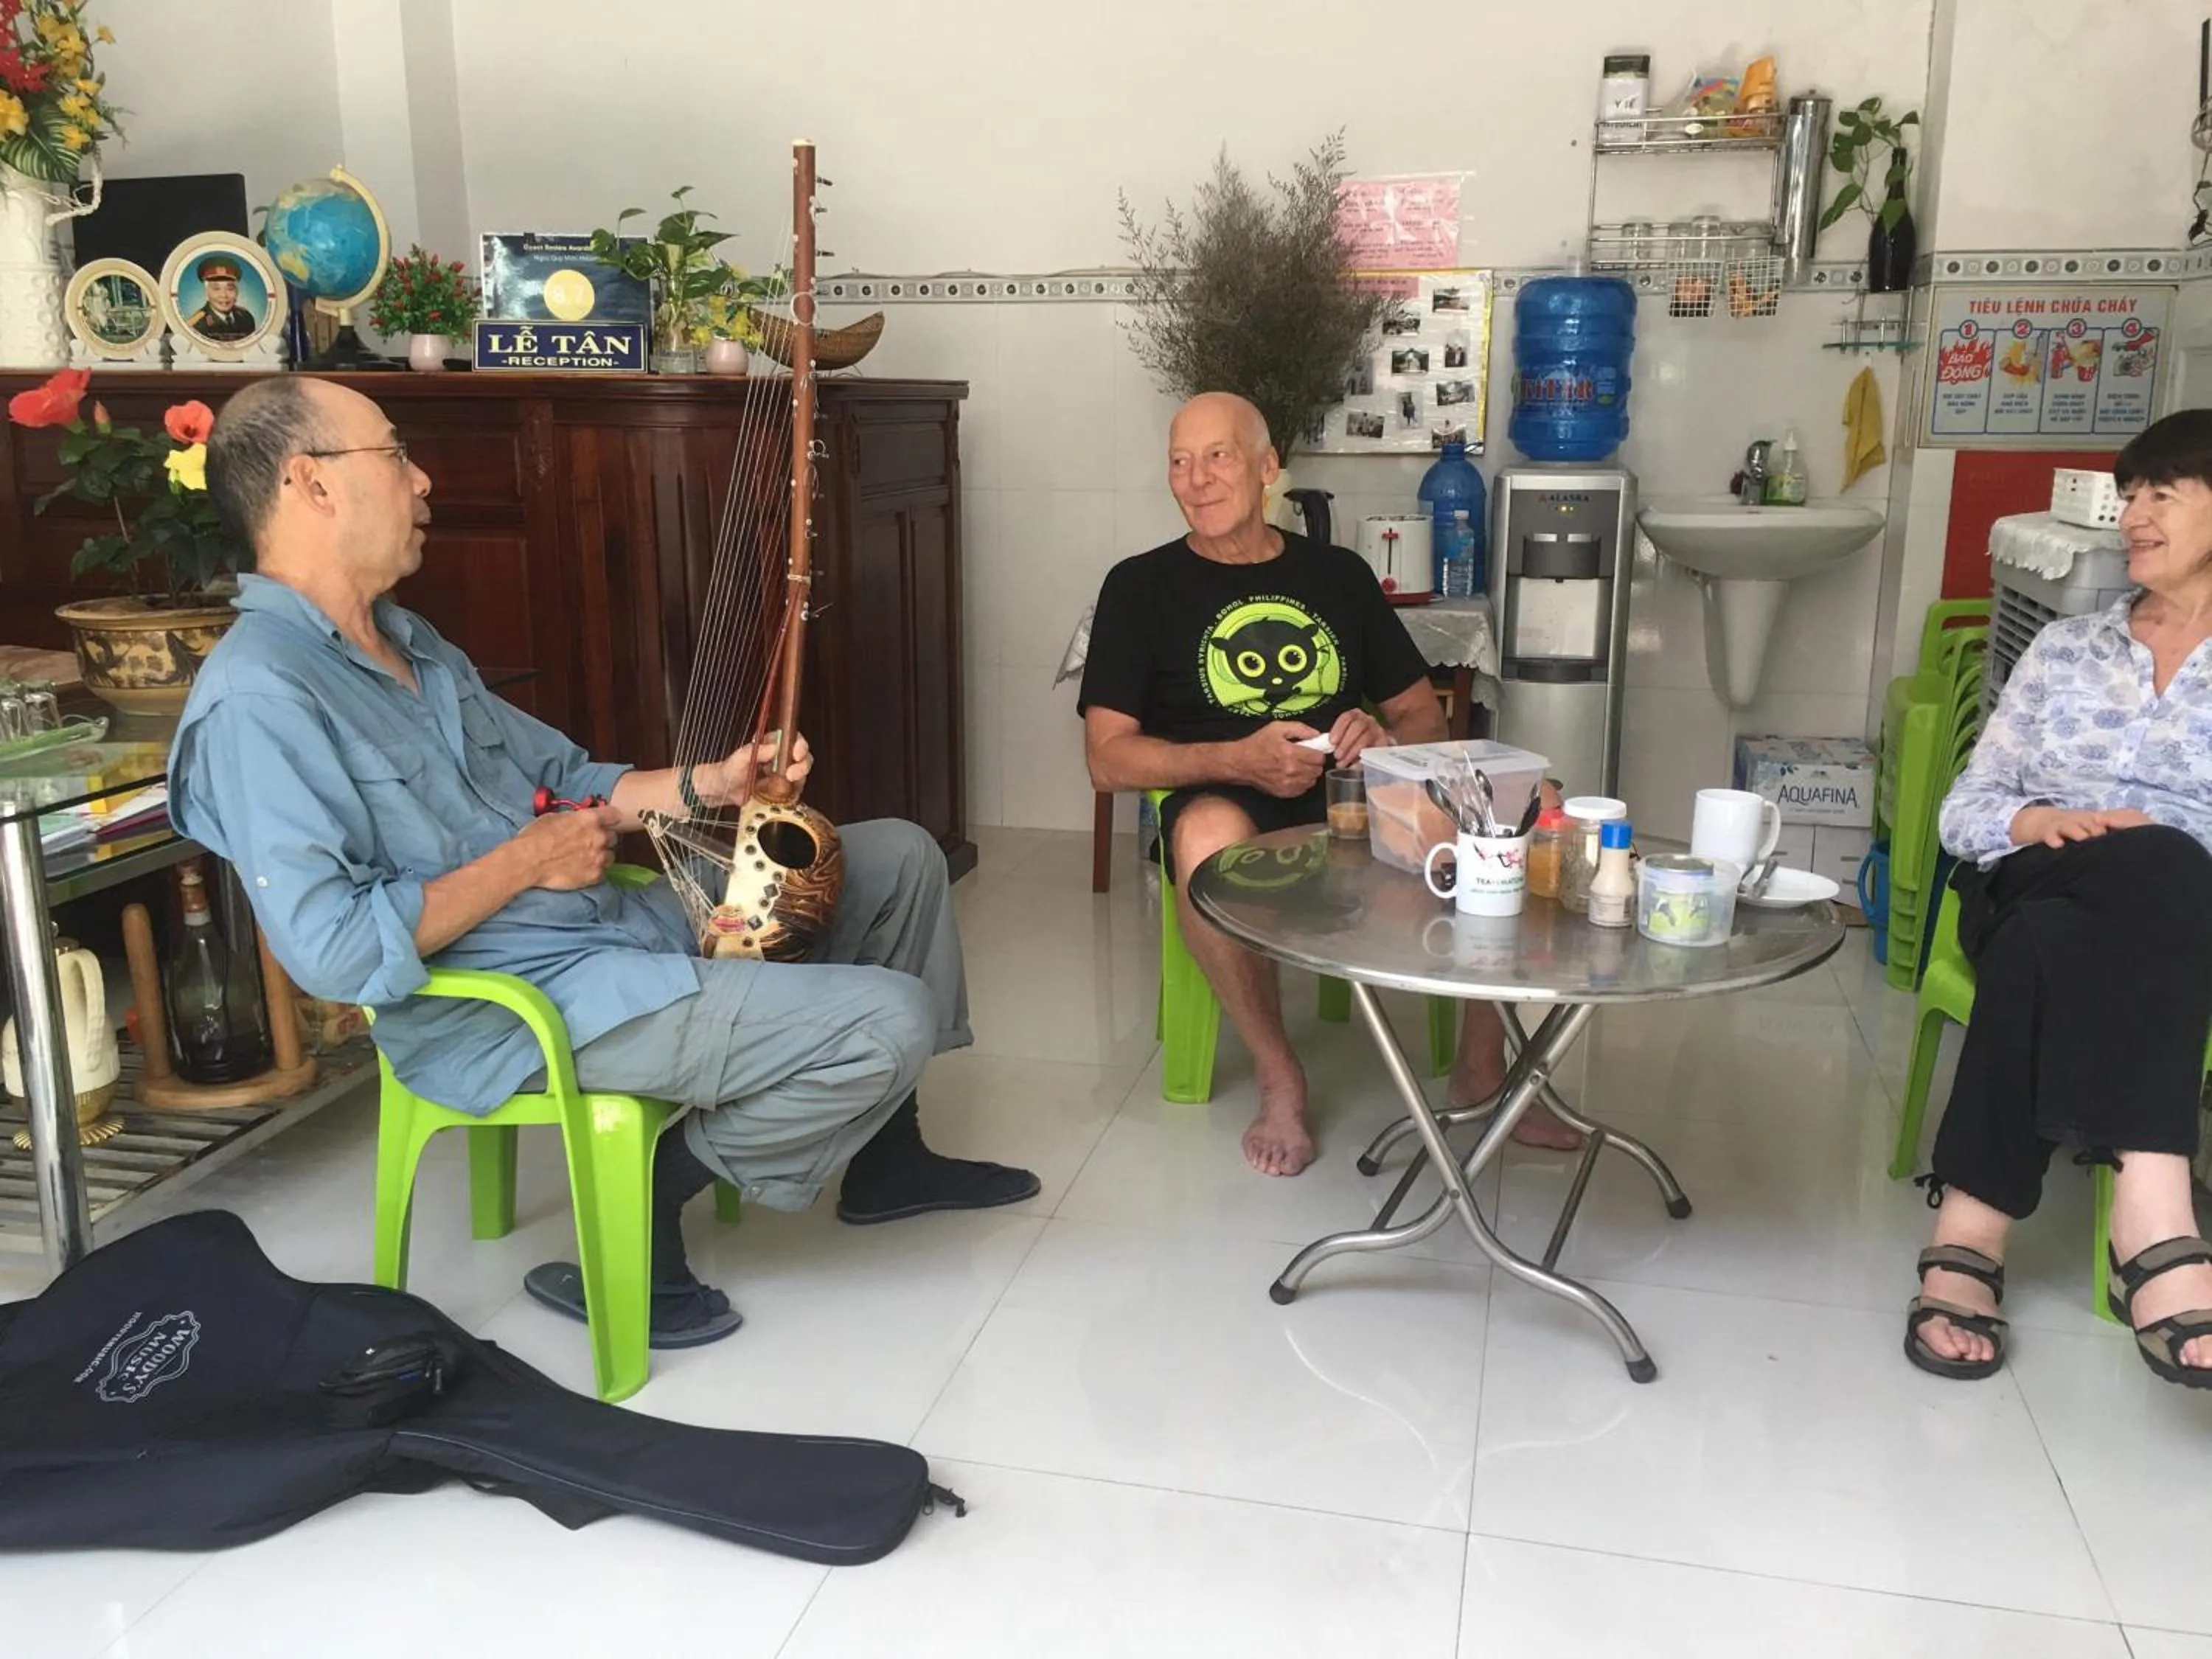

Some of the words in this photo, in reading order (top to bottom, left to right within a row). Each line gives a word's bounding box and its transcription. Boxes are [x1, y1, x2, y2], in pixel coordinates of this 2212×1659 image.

[1969, 297, 2001, 314] TIÊU
[2006, 297, 2046, 316] LỆNH
[2097, 296, 2138, 313] CHÁY
[1964, 322, 1974, 335] 1
[2017, 322, 2028, 334] 2
[2072, 321, 2083, 333] 3
[2125, 321, 2137, 333] 4
[487, 325, 538, 354] LỄ
[551, 330, 632, 355] TÂN
[1776, 784, 1858, 809] AQUAFINA
[117, 1331, 167, 1380] MUSIC
[122, 1328, 191, 1394] WOODY'S
